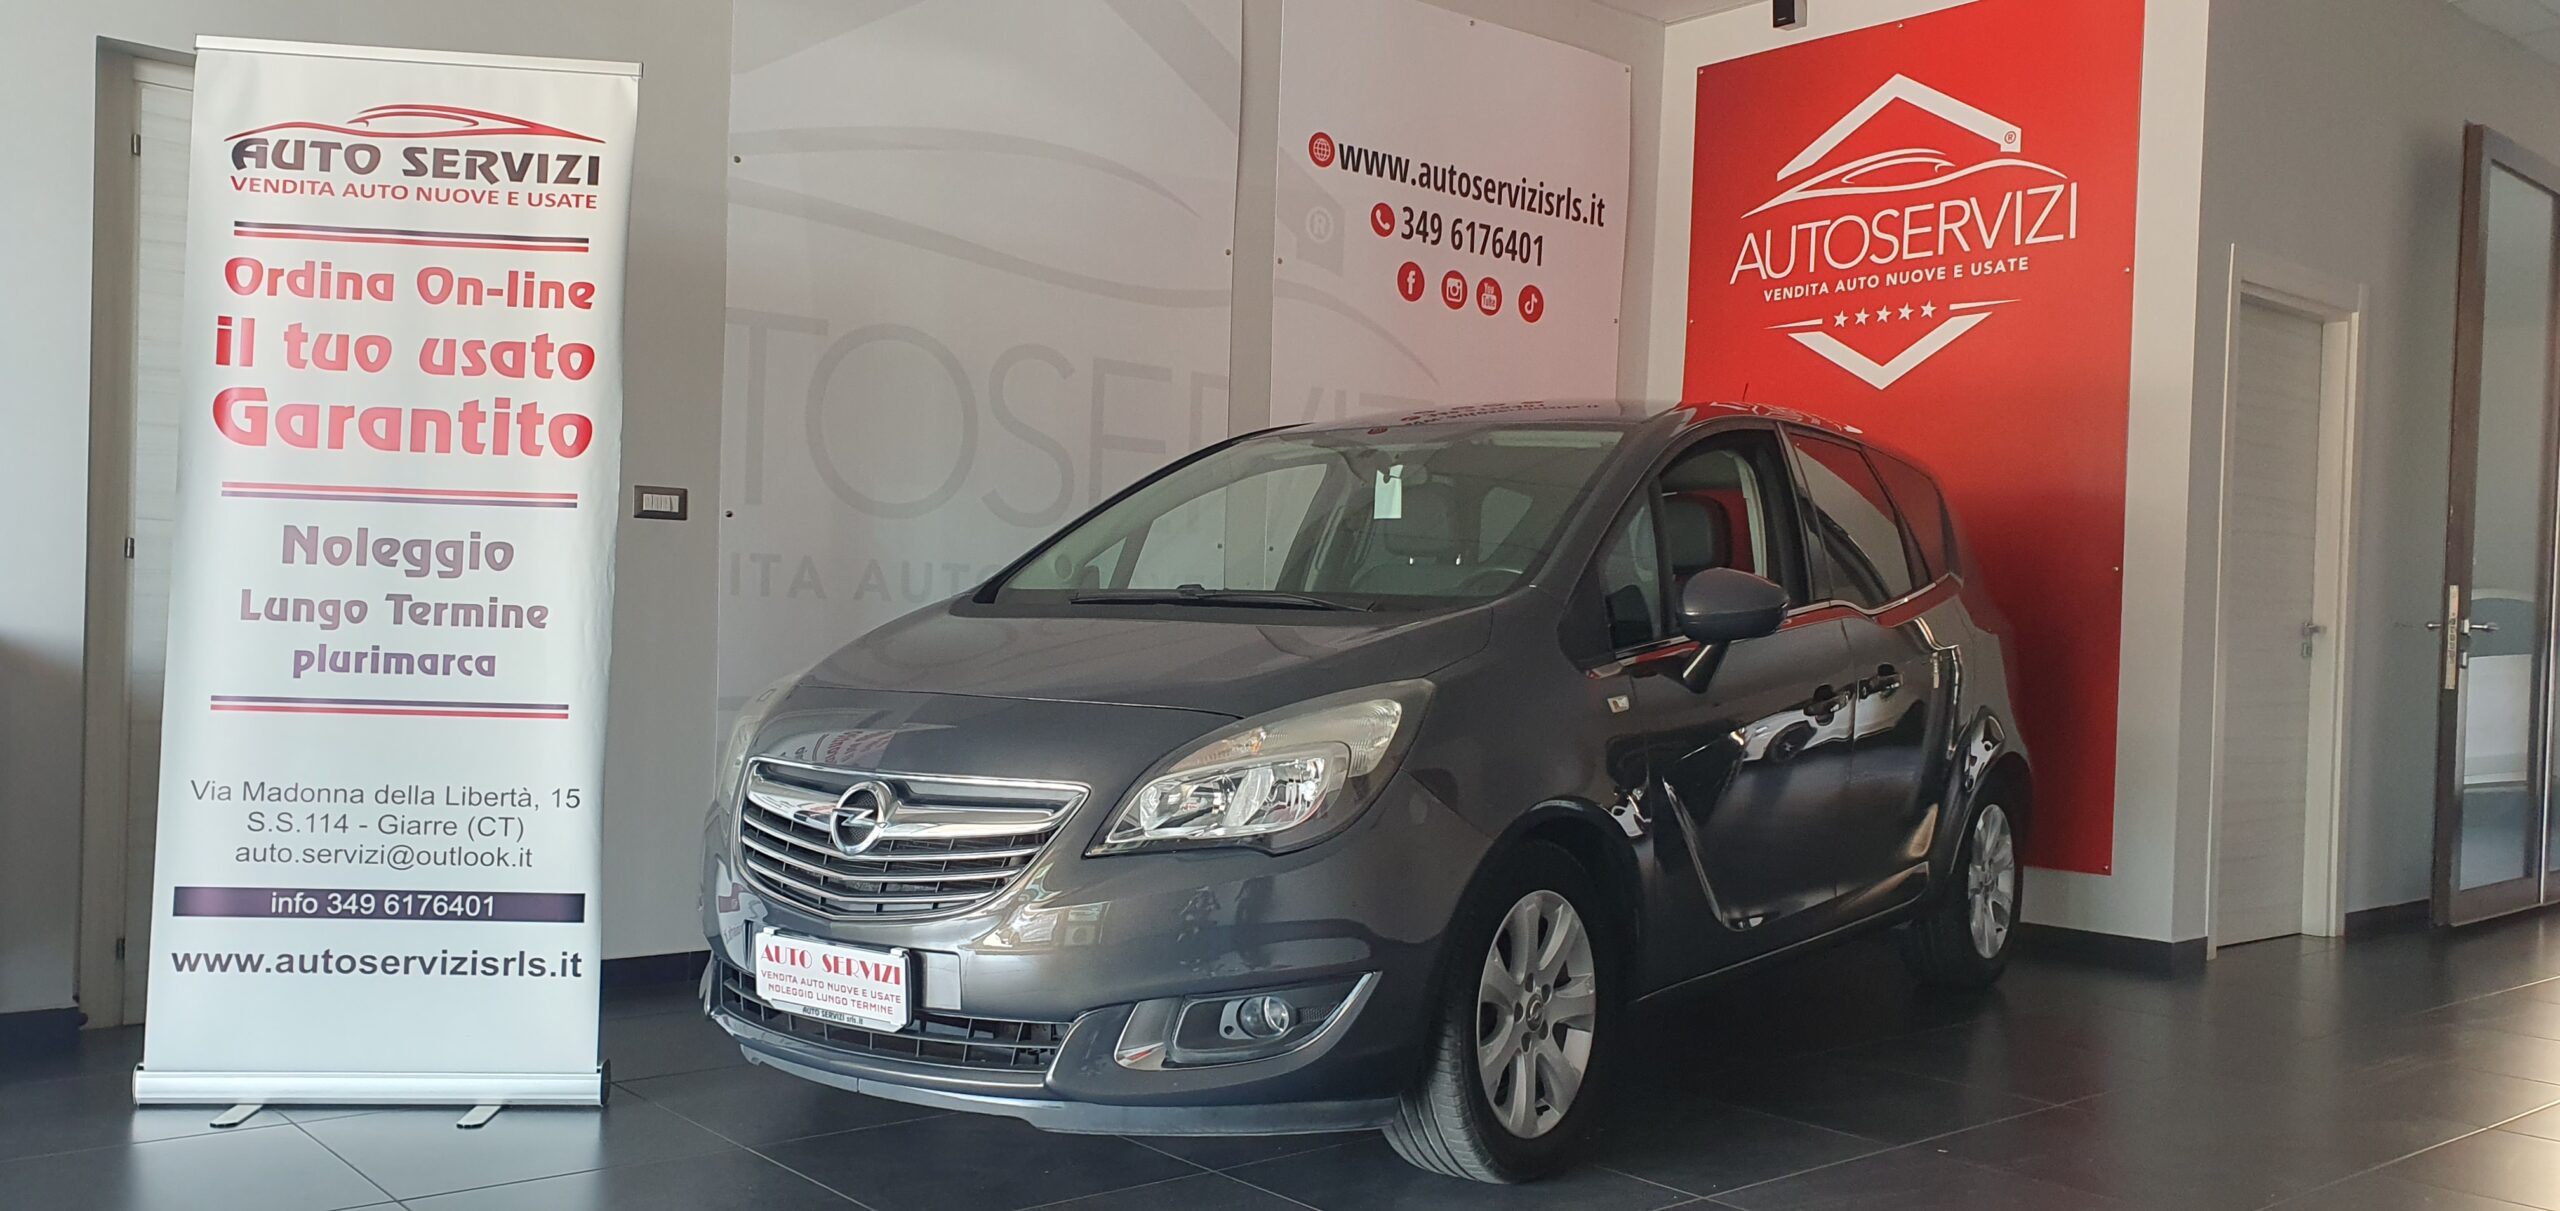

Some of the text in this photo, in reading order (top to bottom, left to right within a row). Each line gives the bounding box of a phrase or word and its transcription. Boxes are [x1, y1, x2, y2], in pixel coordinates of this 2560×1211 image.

[232, 138, 600, 186] AUTO SERVIZI
[231, 176, 597, 209] VENDITA AUTO NUOVE E USATE
[1338, 144, 1605, 227] www.autoservizisrls.it
[1401, 206, 1543, 266] 349 6176401
[1730, 182, 2078, 285] AUTOSERVIZI
[224, 257, 596, 310] Ordina On-line
[1763, 257, 2029, 301] VENDITA AUTO NUOVE E USATE
[216, 315, 595, 381] il tuo usato
[212, 387, 593, 459] Garantito
[281, 525, 515, 578] Noleggio
[241, 588, 549, 630] Lungo Termine
[293, 645, 496, 679] plurimarca
[190, 779, 581, 812] Via Madonna della Libertà, 15
[247, 812, 349, 834] S.S.114
[377, 814, 458, 837] Giarre
[466, 816, 525, 843] (CT)
[234, 844, 532, 870] auto.servizi@outlook.it
[271, 891, 495, 917] info 349 6176401
[172, 948, 583, 979] www.autoservizisrls.it
[761, 944, 900, 985] AUTO SERVIZI
[761, 969, 901, 1003] VENDITA AUTO NUOVE E USATE
[769, 984, 893, 1014] NOLEGGIO LUNGO TERMINE
[803, 1007, 819, 1016] AUTO
[822, 1010, 845, 1020] SERVIZI
